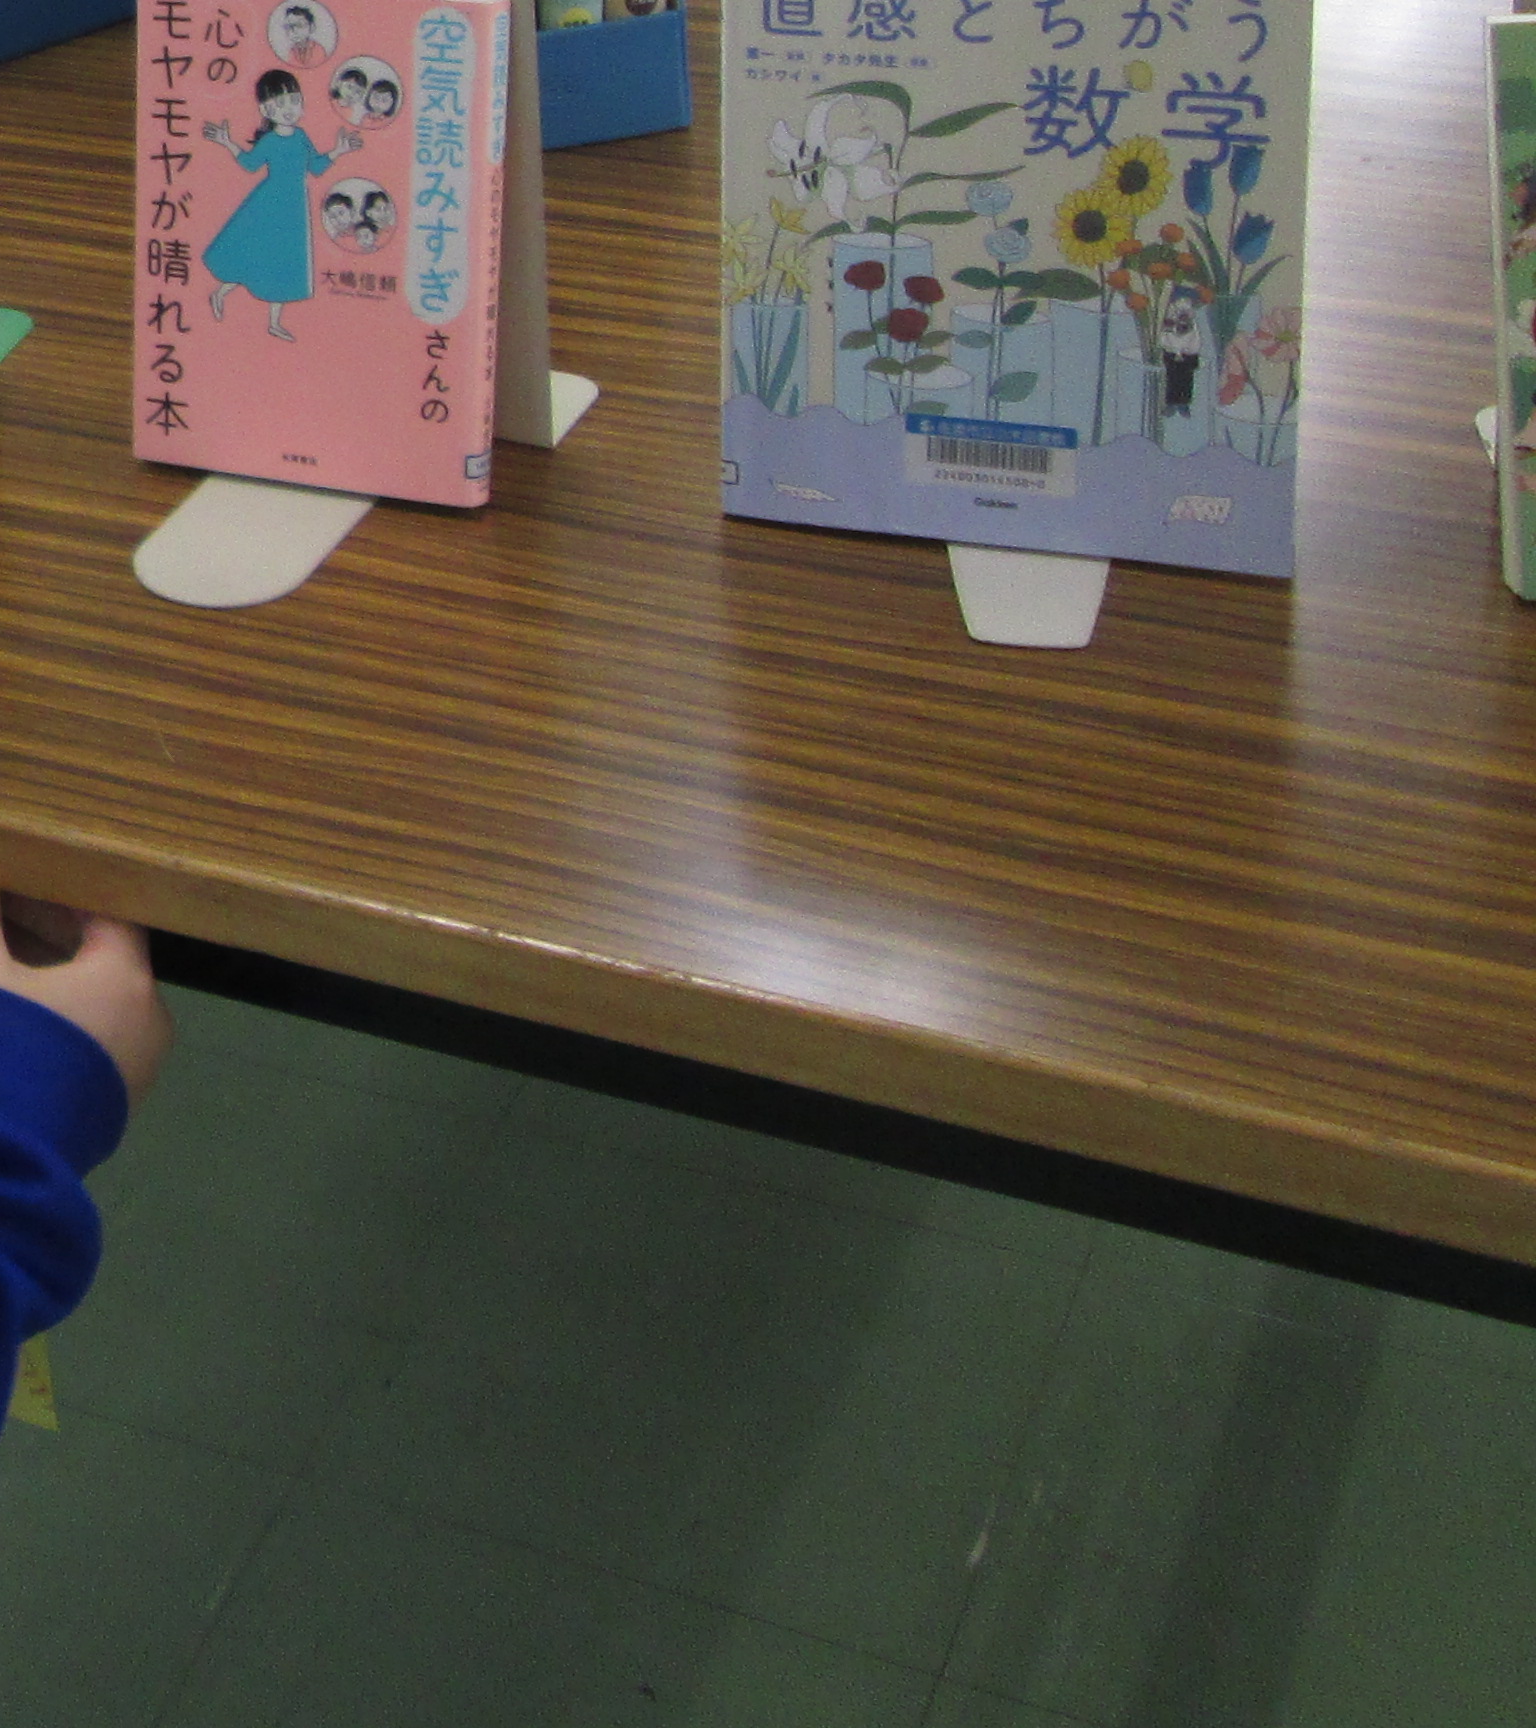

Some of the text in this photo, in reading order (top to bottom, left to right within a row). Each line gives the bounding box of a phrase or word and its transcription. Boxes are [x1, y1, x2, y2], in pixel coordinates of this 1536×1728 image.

[204, 8, 246, 85] 心の
[1023, 66, 1271, 170] 数学
[145, 0, 193, 436] モヤモヤが晴れる本
